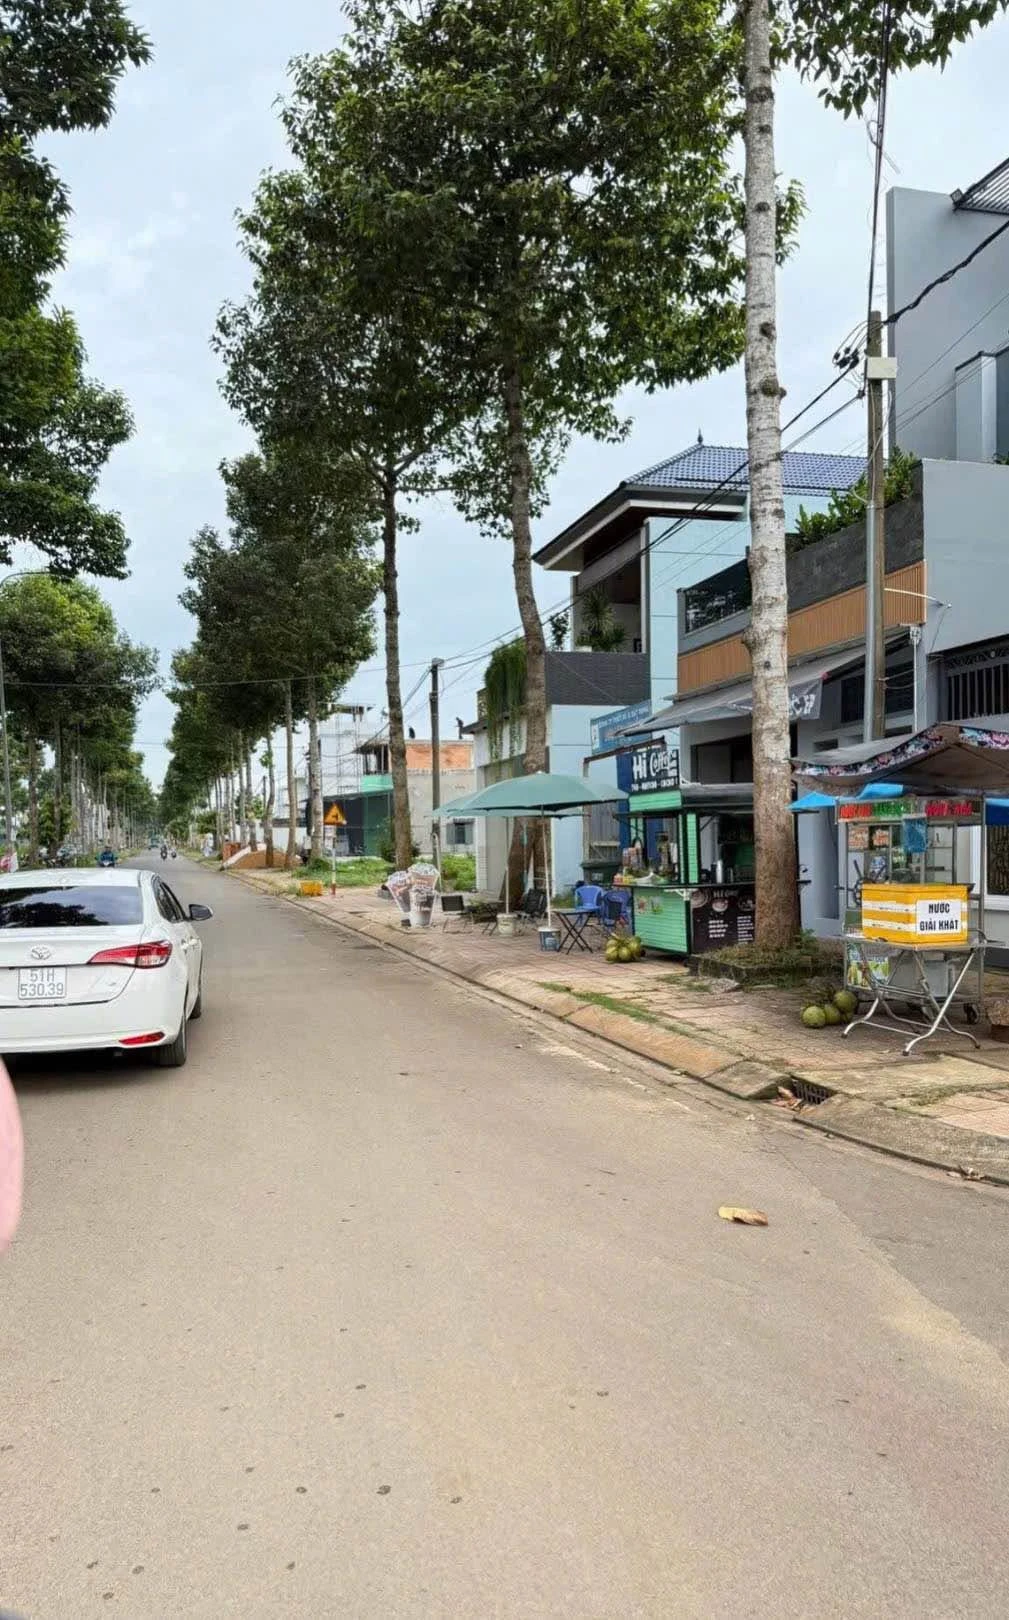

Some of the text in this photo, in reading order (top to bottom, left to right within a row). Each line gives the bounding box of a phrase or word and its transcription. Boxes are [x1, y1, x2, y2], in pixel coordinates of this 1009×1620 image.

[633, 752, 647, 780] Hi
[928, 902, 950, 914] NƯỚC
[938, 919, 959, 931] KHÁT
[30, 968, 55, 982] 51H
[20, 982, 64, 997] 530.39
